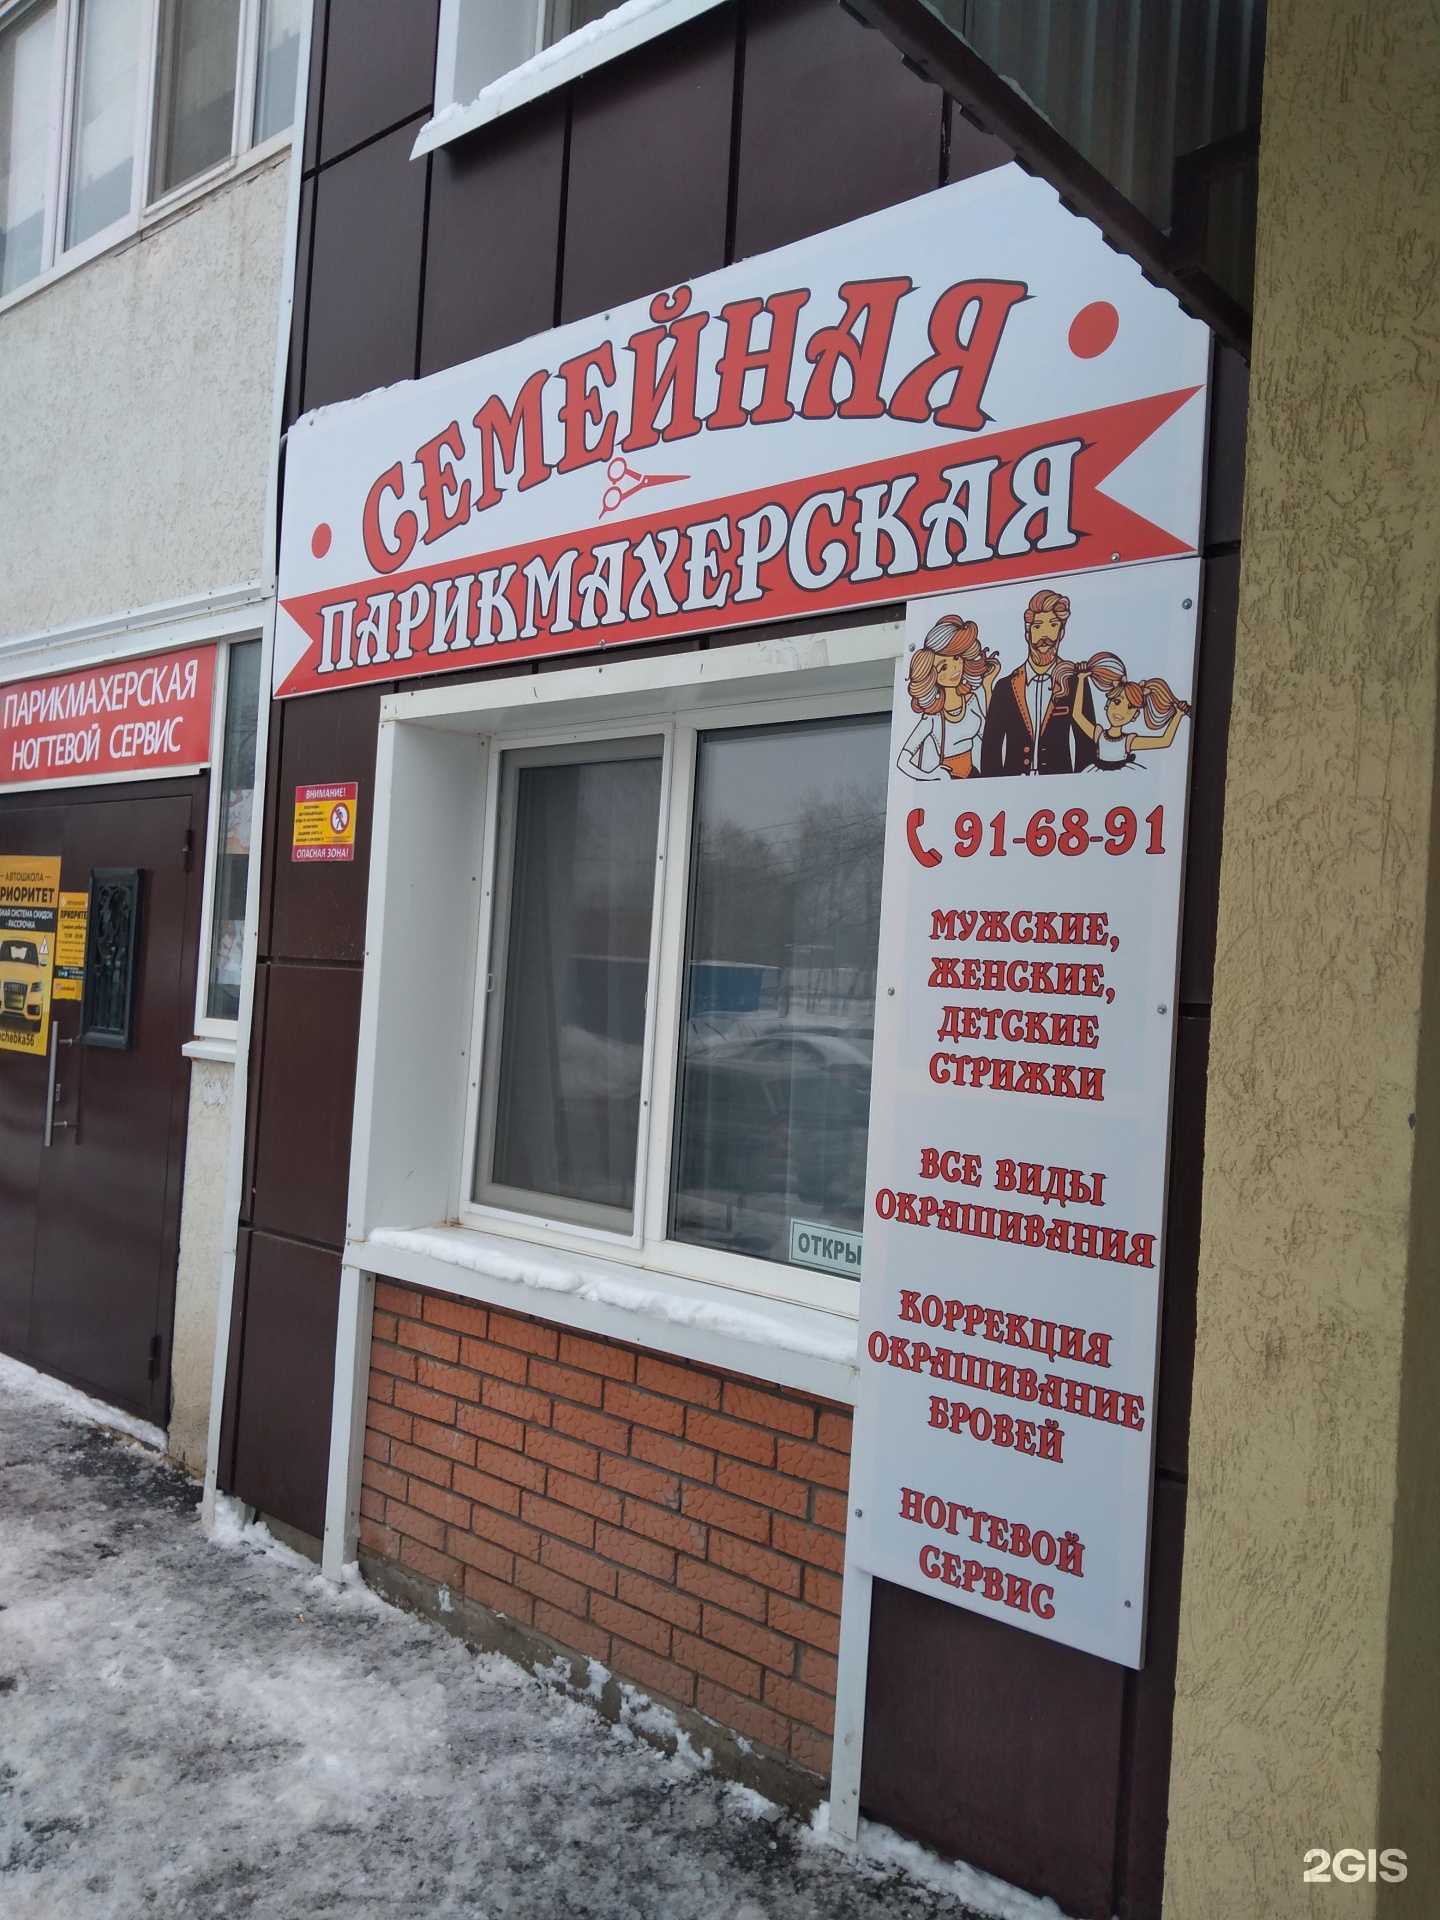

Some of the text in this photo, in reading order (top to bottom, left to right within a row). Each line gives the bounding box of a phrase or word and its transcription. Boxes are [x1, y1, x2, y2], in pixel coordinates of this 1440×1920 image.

[362, 276, 1037, 575] СЕМЕЙНАЯ
[316, 438, 1096, 674] ПАРИКМАХЕРСКАЯ
[3, 659, 198, 729] ПАРИКМАХЕРСКАЯ
[11, 716, 184, 771] НОГТЕВОЙ СЕРВИС
[305, 787, 346, 799] ВНИМАНИЕ!
[296, 847, 349, 859] ОПАСНАЯ ЗОНА!
[954, 804, 1166, 858] 91-68-91
[0, 886, 55, 903] РИОРИТЕТ
[5, 872, 44, 882] АВТОШКОЛА
[928, 909, 1120, 953] МУЖСКИЕ,
[928, 957, 1116, 1004] ЖЕНСКИЕ,
[937, 1005, 1100, 1049] ДЕТСКИЕ
[928, 1052, 1106, 1101] СТРИЖКИ
[919, 1147, 1106, 1208] ВСЕ ВИДЫ
[798, 1232, 862, 1265] ОТКРЫ
[875, 1188, 1156, 1268] ОКРАШИВАНИЯ
[898, 1289, 1113, 1368] КОРРЕКЦИЯ
[867, 1331, 1145, 1431] ОКРАШИВАНИЕ
[928, 1395, 1065, 1463] БРОВЕЙ
[899, 1486, 1086, 1578] НОГТЕВОЙ
[919, 1544, 1056, 1620] СЕРВИС
